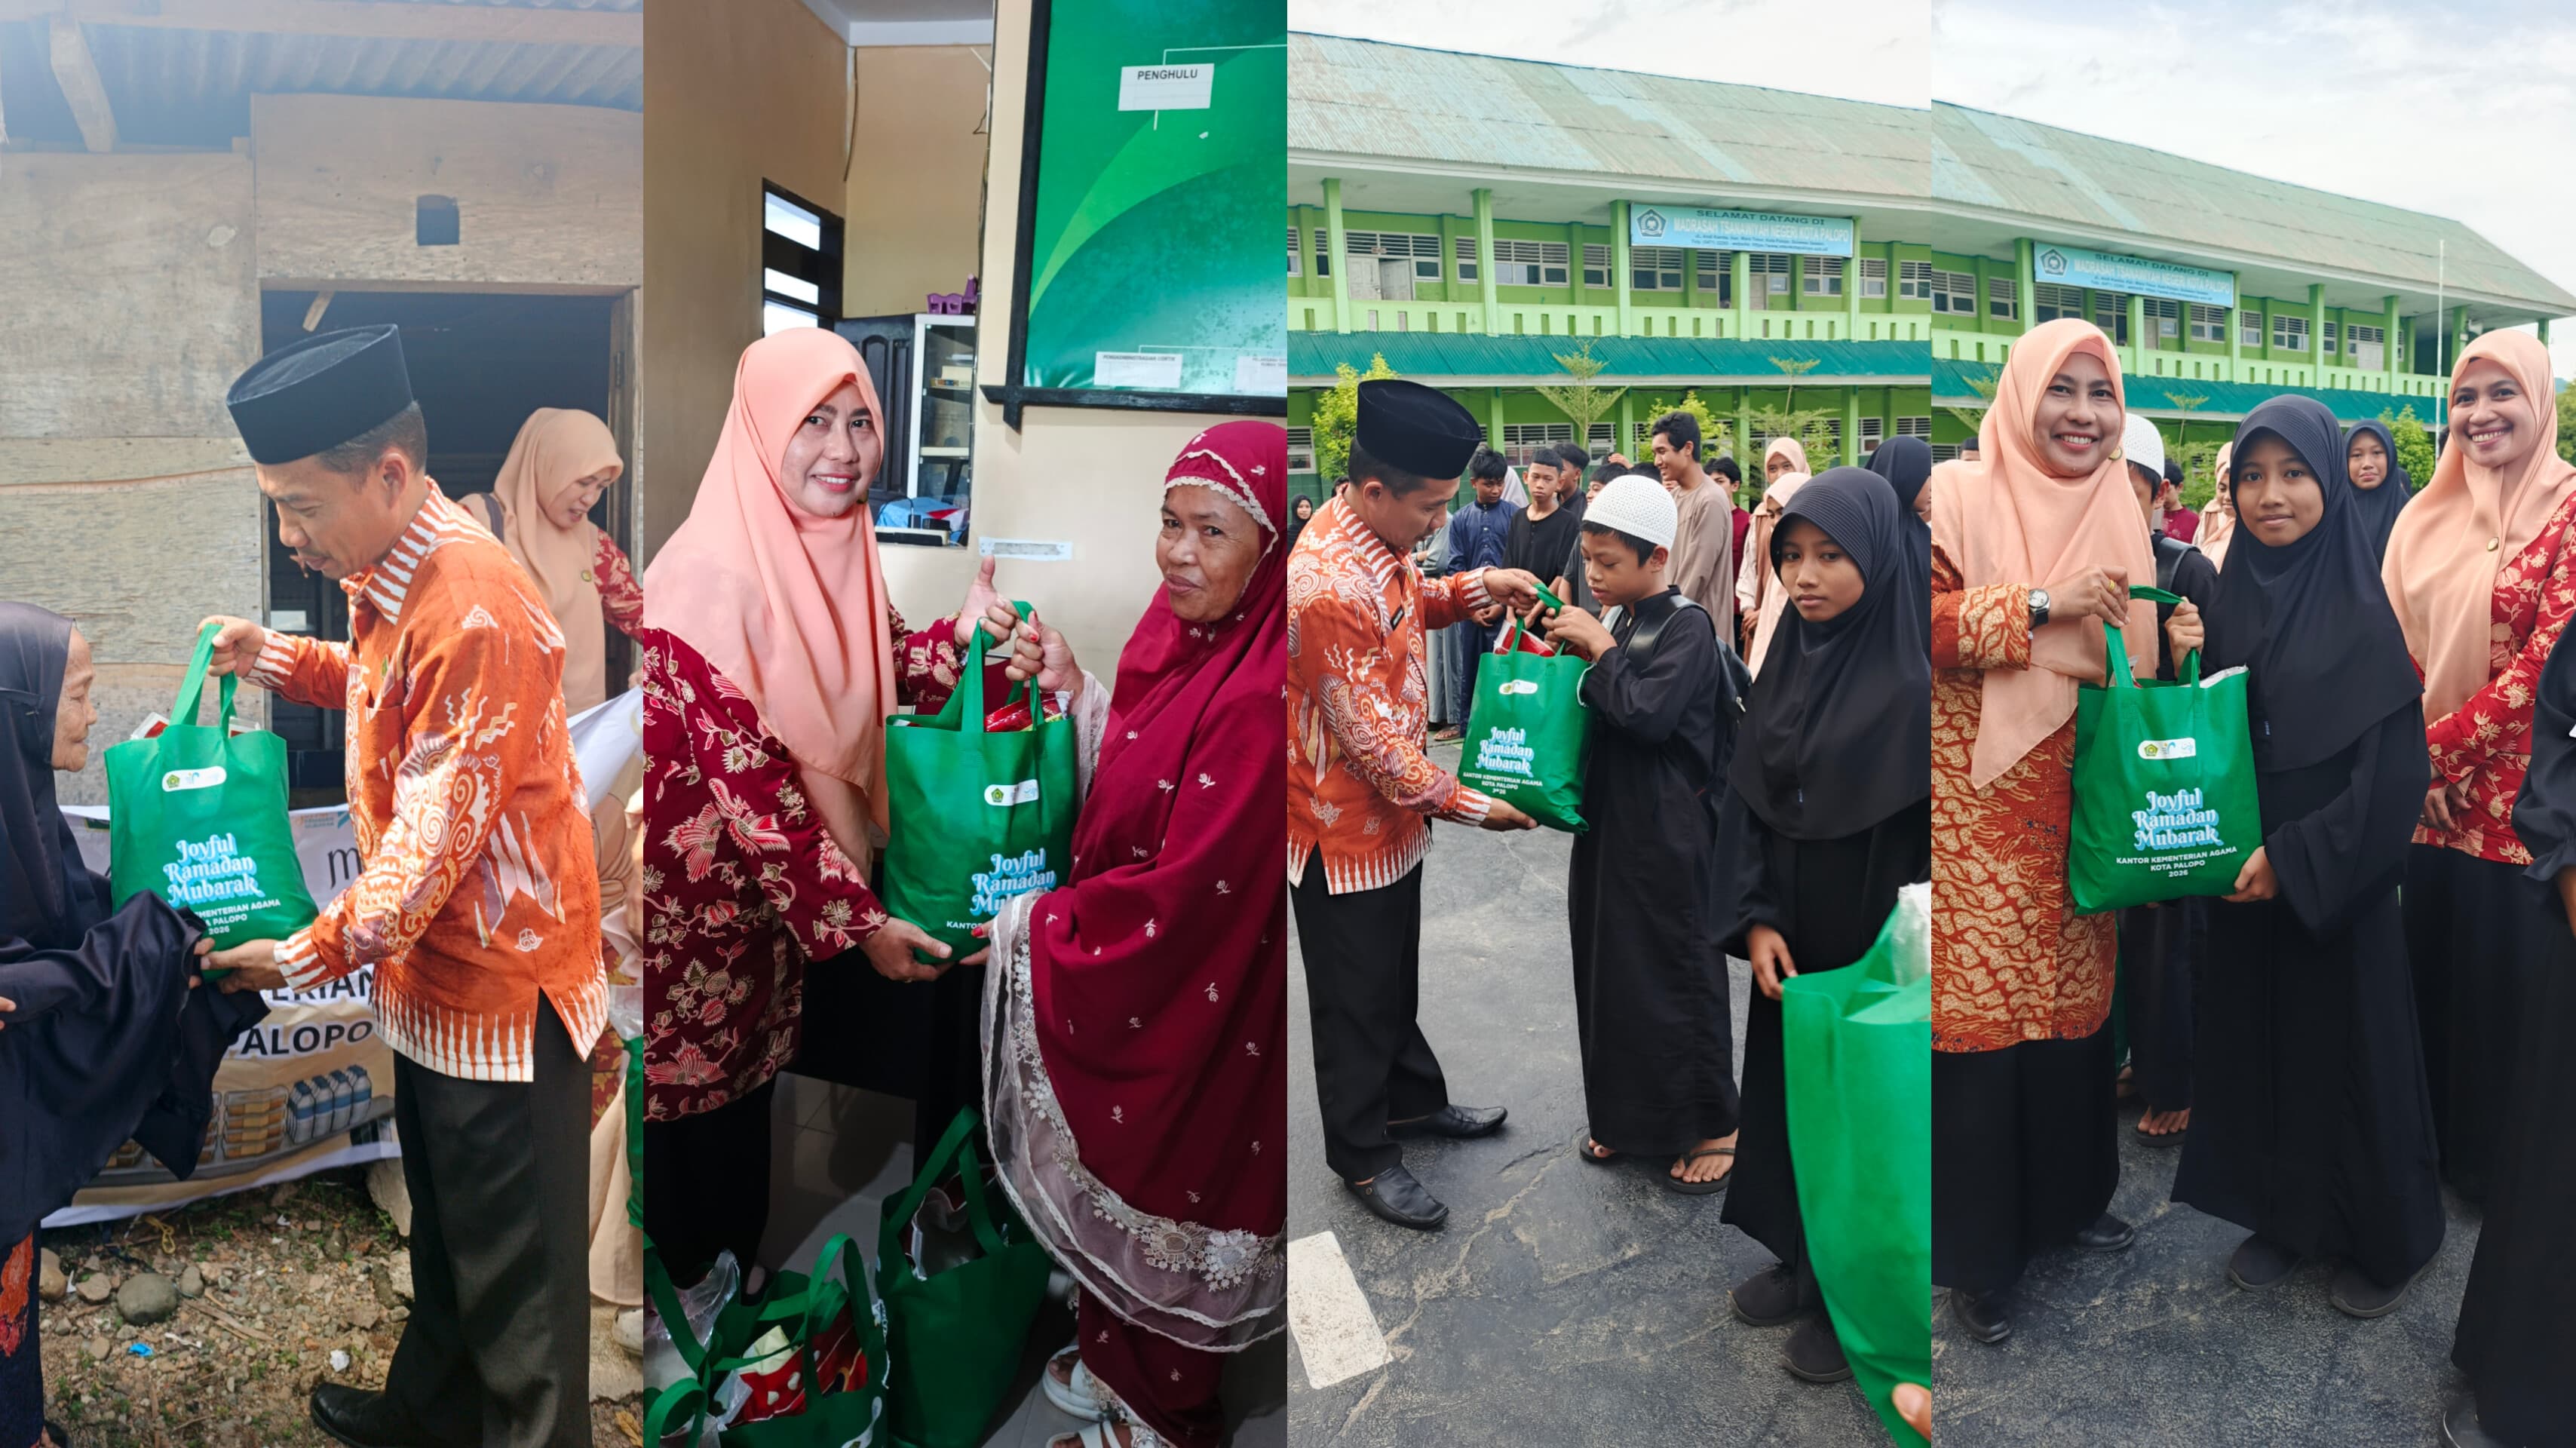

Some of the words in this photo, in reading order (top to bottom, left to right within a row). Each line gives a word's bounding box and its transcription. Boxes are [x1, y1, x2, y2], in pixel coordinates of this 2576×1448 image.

[1137, 69, 1198, 81] PENGHULU
[1696, 210, 1757, 220] SELAMAT
[1759, 214, 1809, 225] DATANG
[2095, 253, 2149, 267] SELAMAT
[2151, 262, 2195, 275] DATANG
[1489, 727, 1526, 744] Joyful
[1480, 740, 1534, 759] Ramadan
[1475, 754, 1534, 778] Mubarak
[2146, 787, 2203, 814] Joyful
[2132, 809, 2219, 831] Ramadan
[2134, 824, 2224, 850] Mubarak
[176, 833, 238, 864] Joyful
[2151, 851, 2208, 864] KEMENTERIAN
[2210, 846, 2237, 857] AGAMA
[163, 854, 256, 884] Ramadan
[989, 848, 1046, 879] Joyful
[2173, 860, 2206, 870] PALOPO
[167, 875, 265, 907] Mubarak
[971, 870, 1056, 895] Ramadan
[194, 903, 249, 919] MENTERIAN
[250, 899, 281, 910] AGAMA
[213, 913, 248, 926] PALOPO
[208, 926, 230, 935] 2026
[240, 1021, 374, 1056] ALOPO
